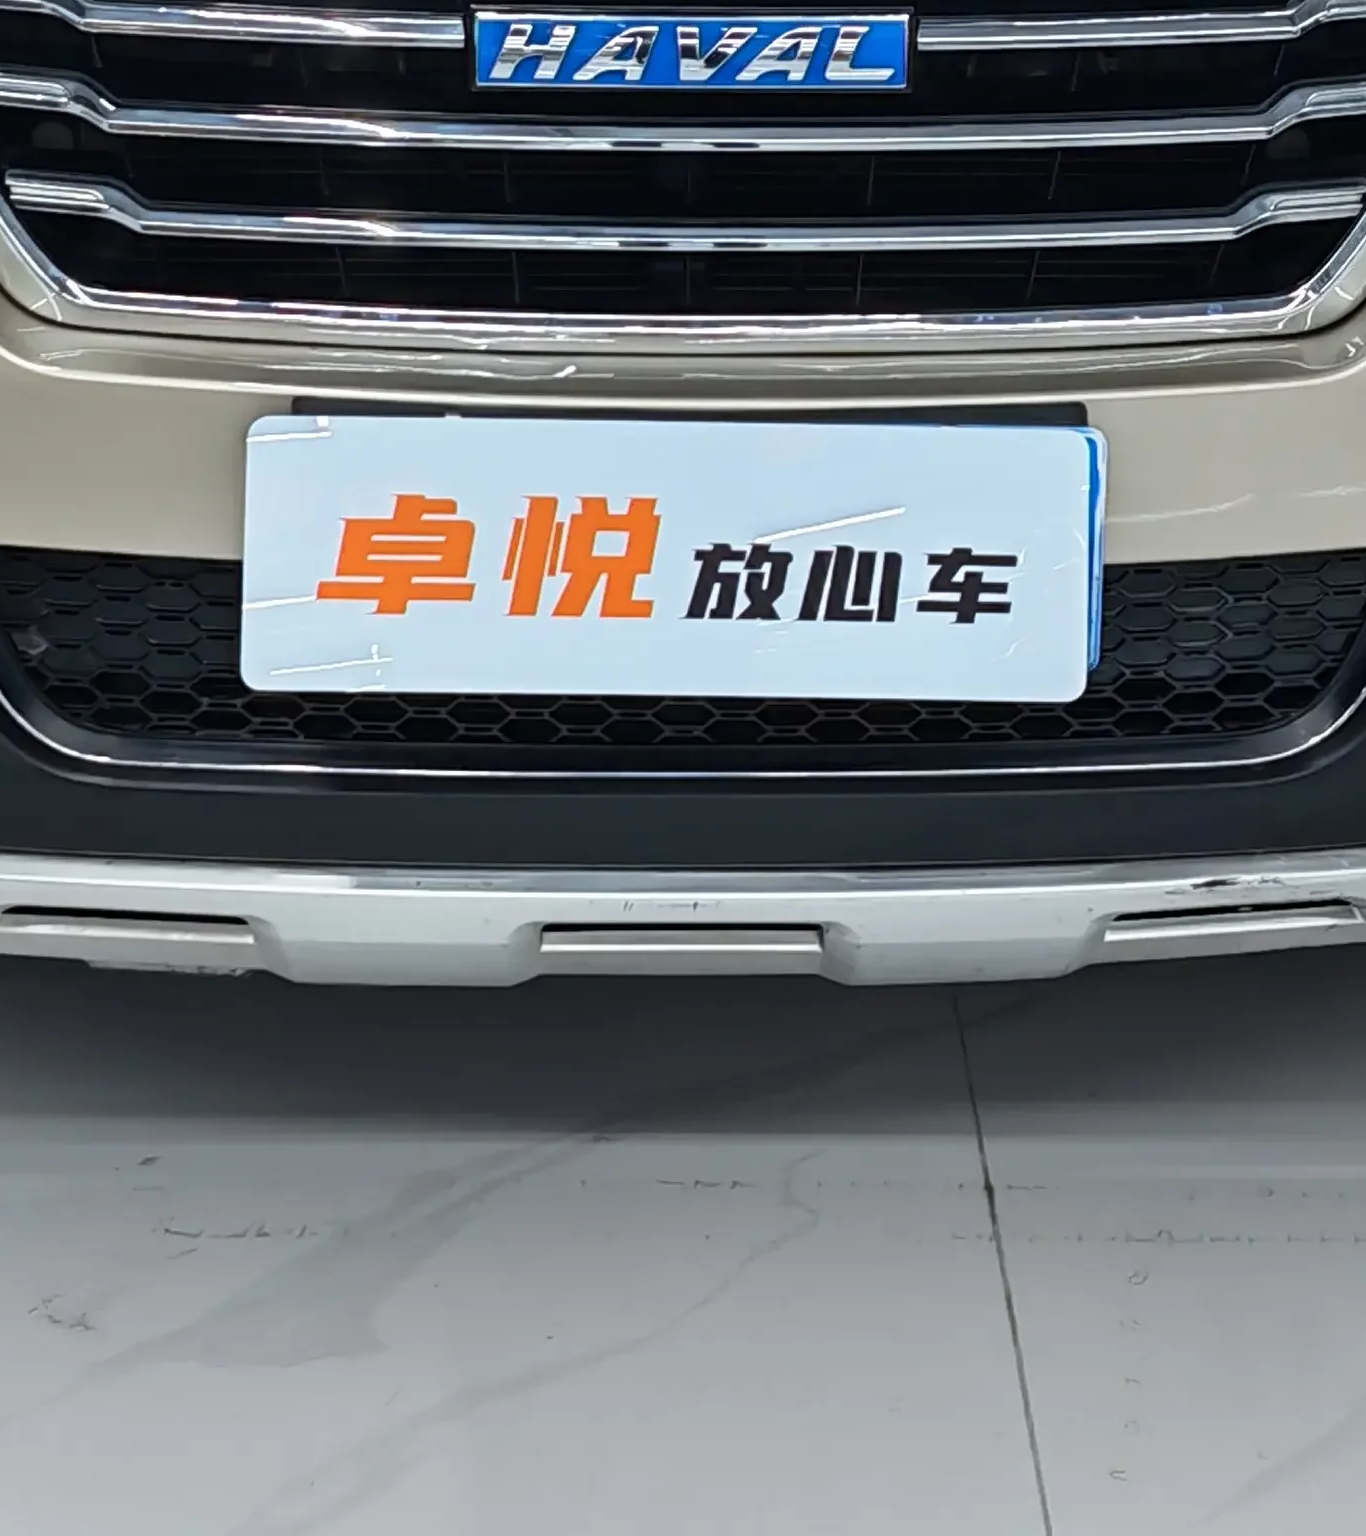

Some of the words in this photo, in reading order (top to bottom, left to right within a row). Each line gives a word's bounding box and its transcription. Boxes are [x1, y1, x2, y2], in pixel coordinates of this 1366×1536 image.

[489, 23, 896, 81] HAVAL
[316, 493, 662, 618] 卓悦
[678, 543, 1018, 624] 放心车
